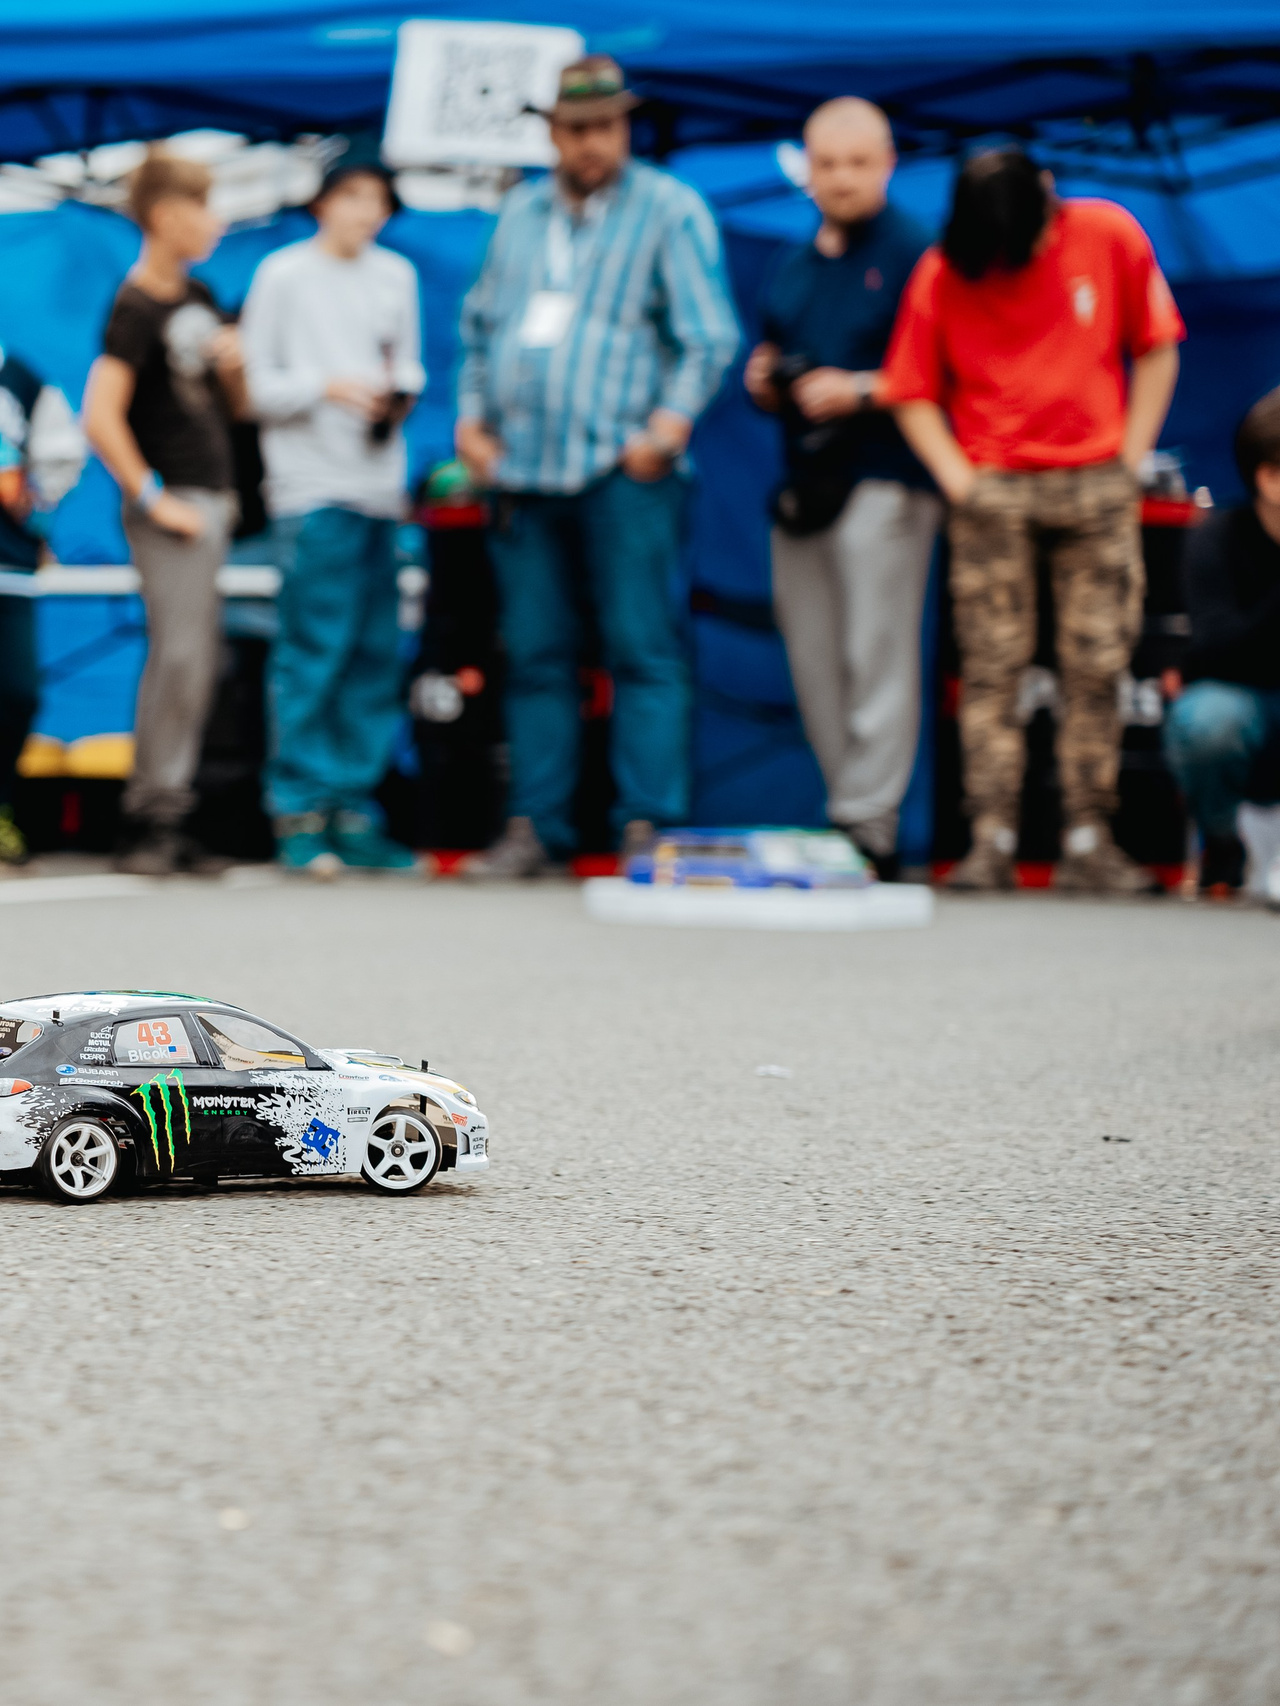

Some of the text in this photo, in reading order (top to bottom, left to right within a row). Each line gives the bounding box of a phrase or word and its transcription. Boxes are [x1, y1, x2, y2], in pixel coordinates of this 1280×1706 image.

[137, 1021, 172, 1047] 43
[128, 1048, 170, 1063] Blcok
[192, 1094, 258, 1110] MONSTER
